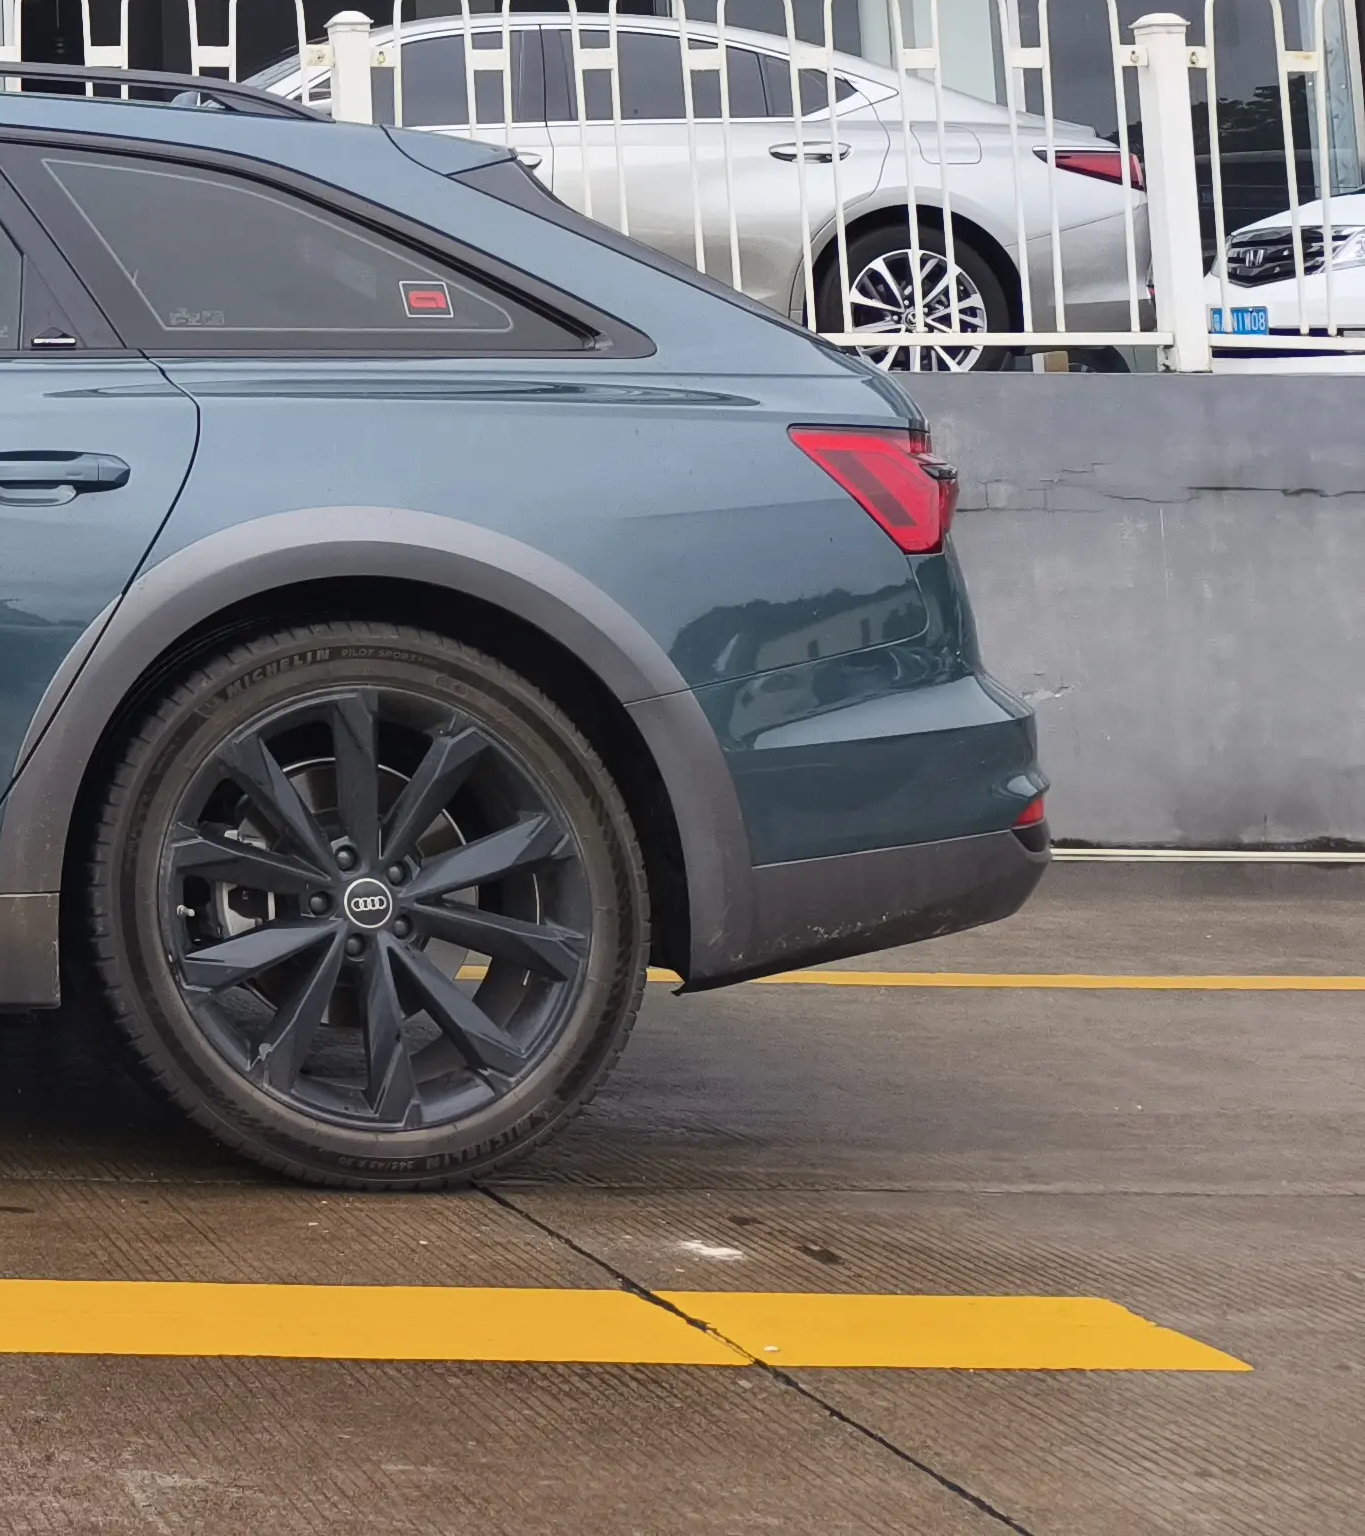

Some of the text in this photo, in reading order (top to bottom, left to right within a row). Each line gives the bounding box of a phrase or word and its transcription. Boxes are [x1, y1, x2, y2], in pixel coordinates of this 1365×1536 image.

[1213, 311, 1267, 332] N1W08
[226, 648, 331, 700] MICHELIN
[341, 648, 374, 658] PILOT
